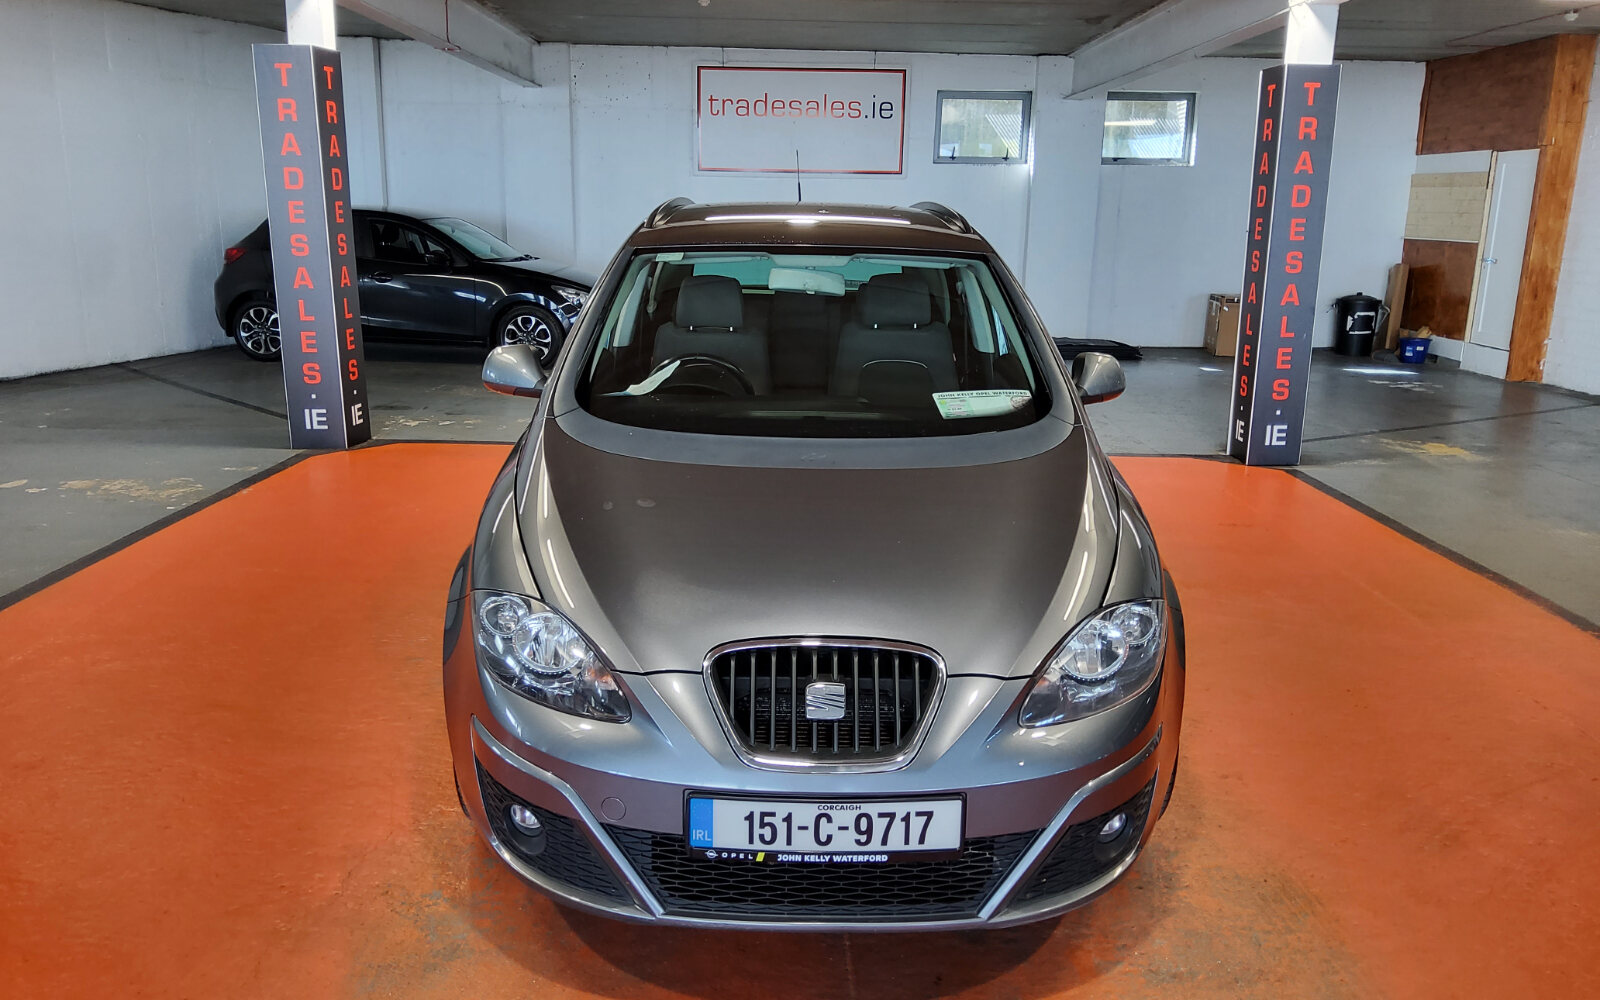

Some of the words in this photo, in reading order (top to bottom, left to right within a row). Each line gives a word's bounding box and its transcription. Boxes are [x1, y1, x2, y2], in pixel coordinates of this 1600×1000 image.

[708, 92, 894, 120] tradesales.ie
[817, 804, 862, 812] CORCAIGH
[692, 828, 712, 842] IRL
[743, 810, 935, 847] 151-C-9717
[721, 852, 754, 860] OPEL
[777, 853, 802, 862] JOHN
[804, 854, 832, 862] KELLY
[832, 854, 889, 863] WATERFORD
